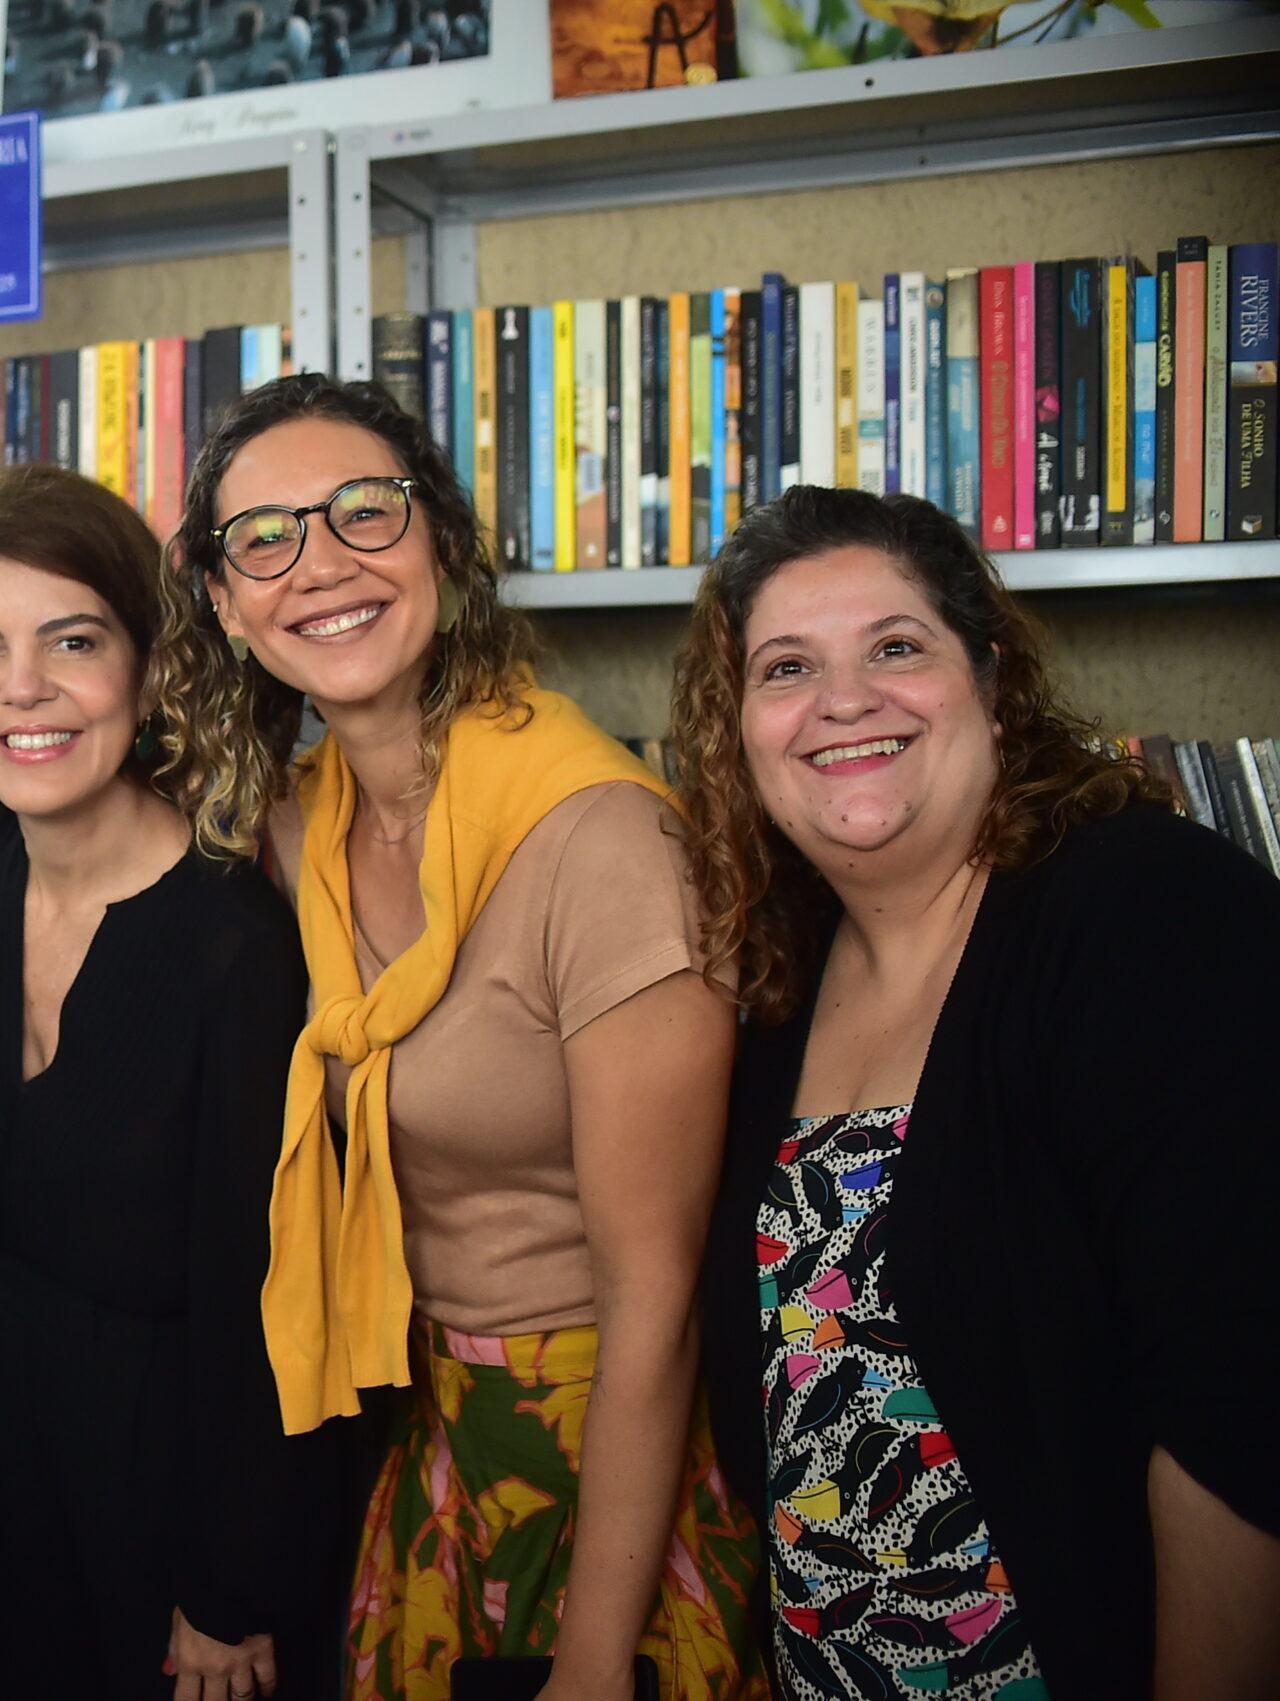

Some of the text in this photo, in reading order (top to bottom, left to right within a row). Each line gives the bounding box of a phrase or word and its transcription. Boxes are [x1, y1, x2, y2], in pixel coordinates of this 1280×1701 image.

[993, 310, 1005, 356] BROWN
[1240, 274, 1258, 348] RIVERS
[1257, 279, 1269, 340] FRANCINE
[1240, 403, 1252, 489] DE UMA FILHA
[1254, 412, 1265, 457] SONHO
